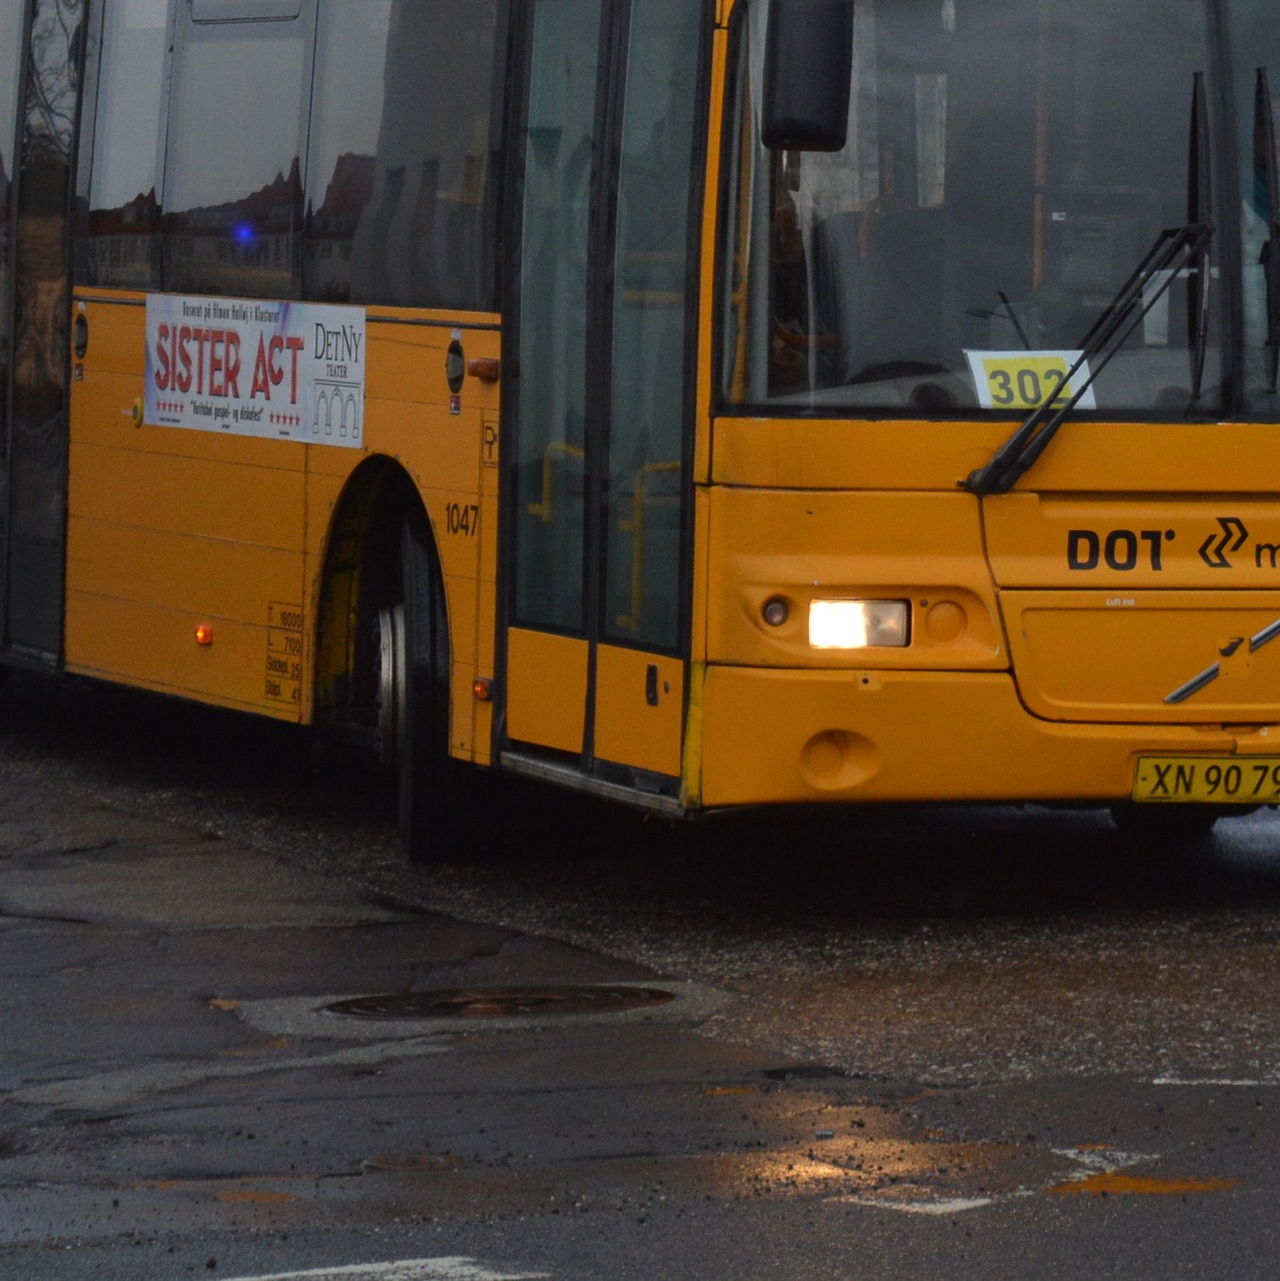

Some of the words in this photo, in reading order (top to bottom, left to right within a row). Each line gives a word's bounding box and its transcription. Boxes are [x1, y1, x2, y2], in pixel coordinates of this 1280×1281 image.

[154, 322, 241, 399] SISTER
[326, 364, 348, 378] TEATER
[989, 369, 1070, 405] 302
[445, 502, 479, 537] 1047
[1067, 528, 1176, 571] DOT
[1150, 764, 1195, 795] XN
[1205, 765, 1242, 795] 90
